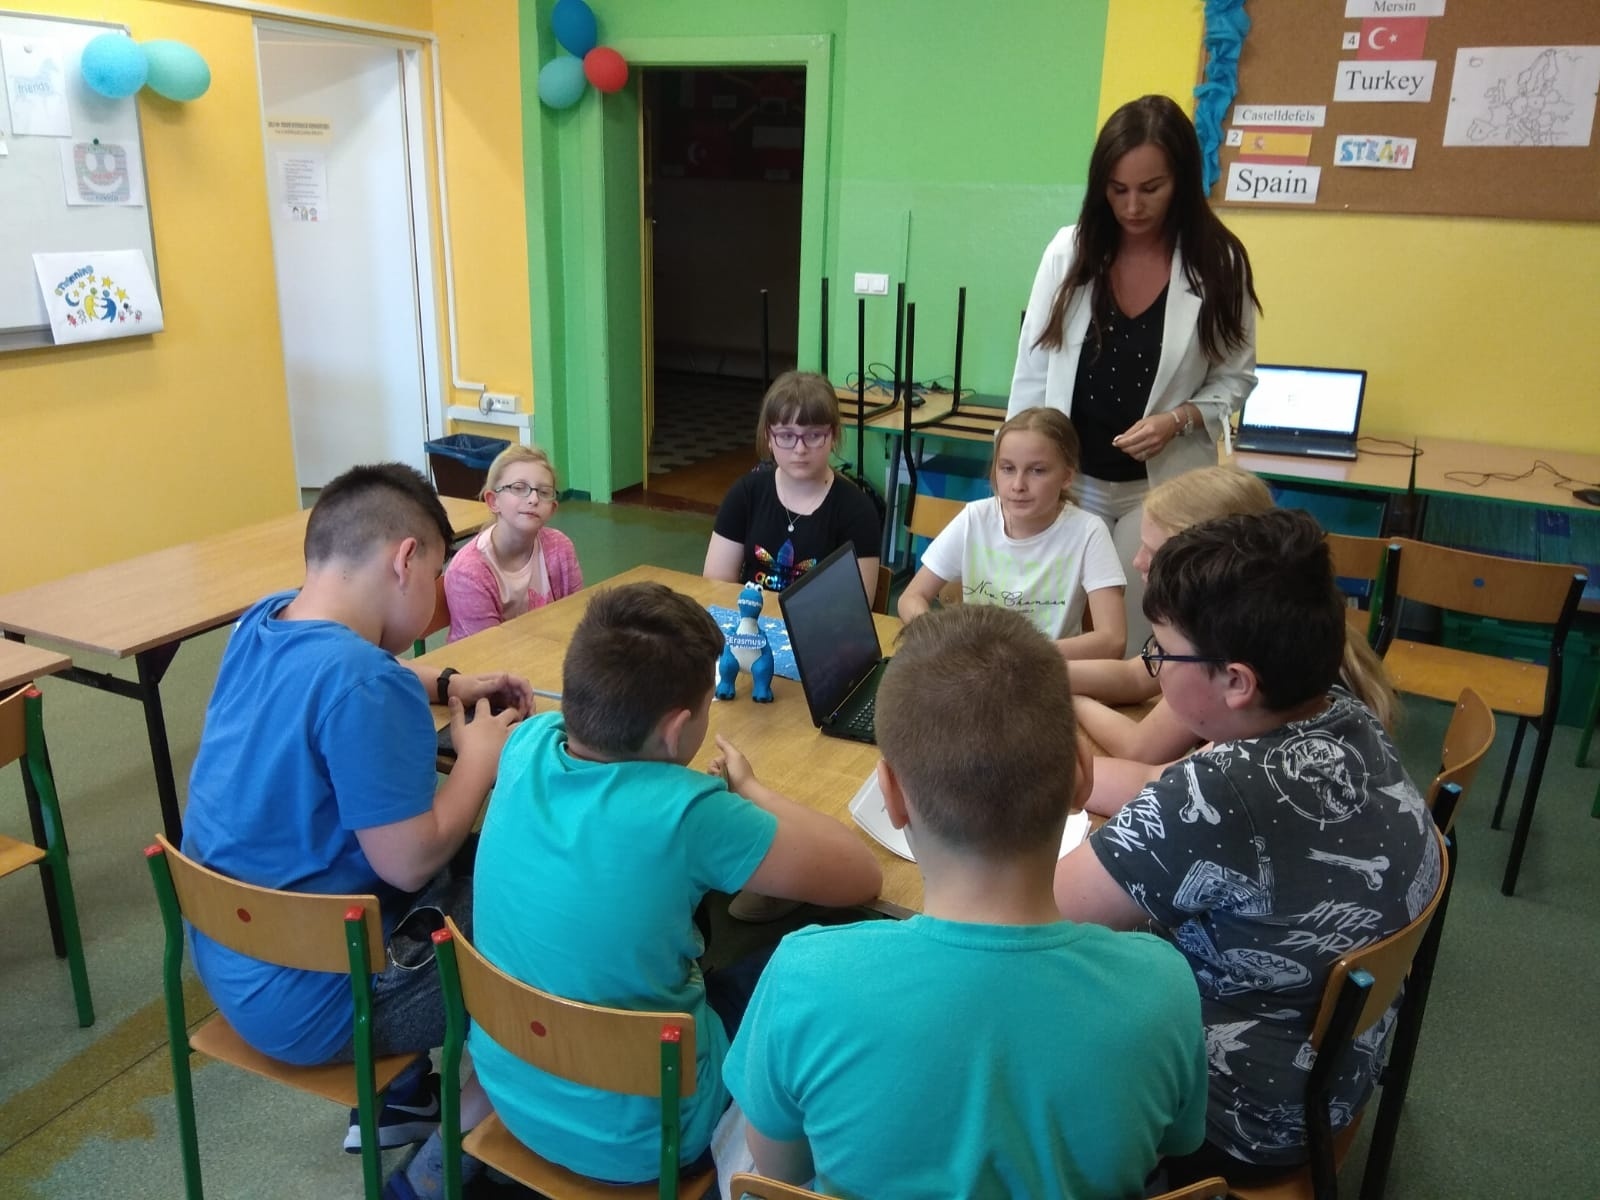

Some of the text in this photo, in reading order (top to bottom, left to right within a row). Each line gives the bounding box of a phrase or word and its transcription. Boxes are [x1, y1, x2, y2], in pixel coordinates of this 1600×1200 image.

[1373, 0, 1416, 12] Mersin
[1347, 34, 1356, 45] 4
[1345, 69, 1424, 96] Turkey
[1242, 109, 1315, 121] Castelldefels
[1231, 132, 1239, 142] 2
[1340, 139, 1409, 164] STEAM
[1236, 168, 1307, 199] Spain
[1288, 899, 1383, 932] AFTER
